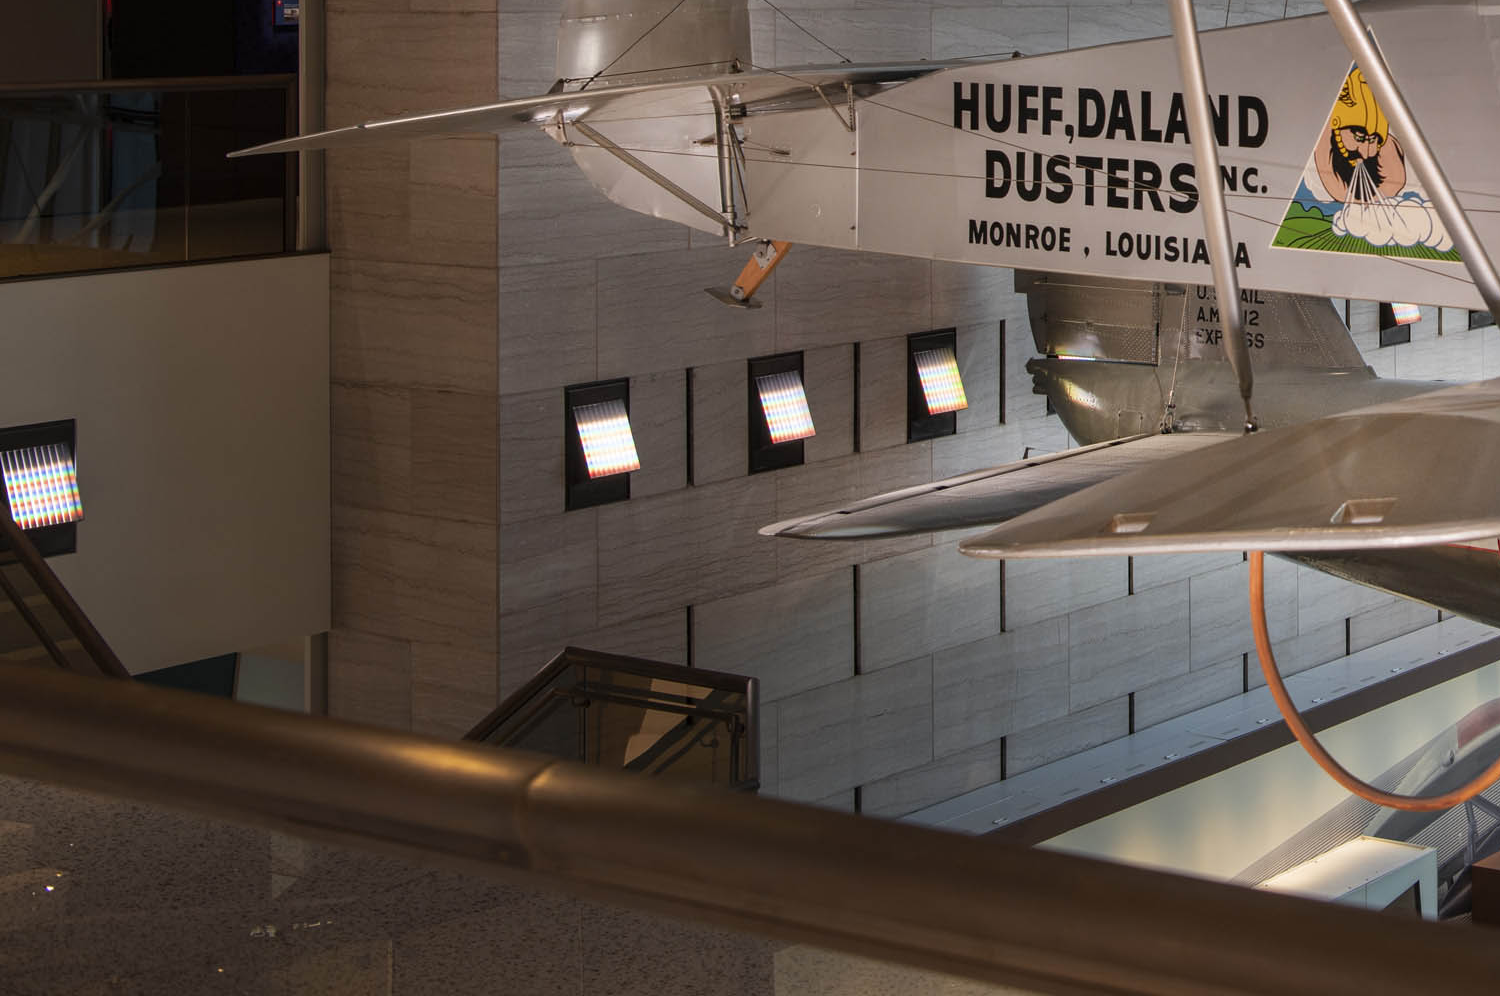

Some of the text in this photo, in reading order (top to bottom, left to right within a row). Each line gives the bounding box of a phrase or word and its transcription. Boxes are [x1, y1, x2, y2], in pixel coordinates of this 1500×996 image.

[985, 150, 1268, 214] DUSTERS NC.
[968, 219, 1071, 252] MONROE
[1106, 231, 1252, 269] LOUISIAA
[1196, 328, 1265, 349] EXPSS
